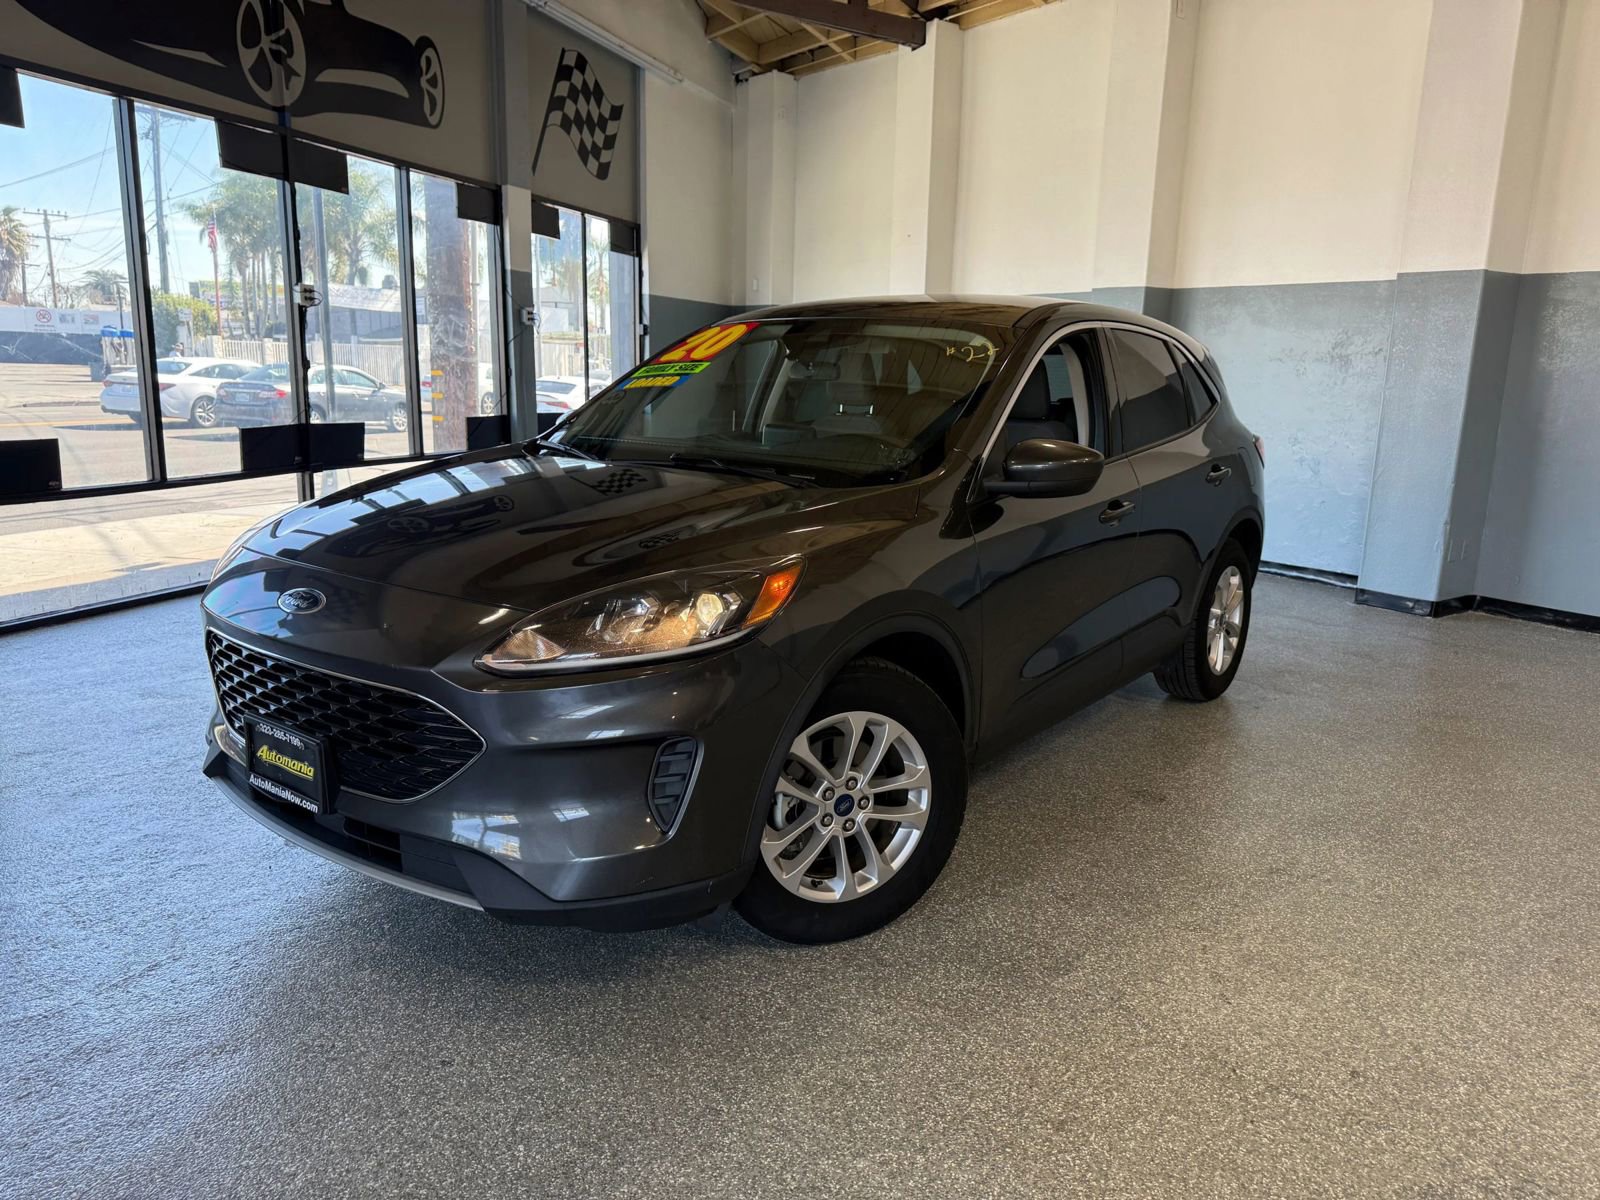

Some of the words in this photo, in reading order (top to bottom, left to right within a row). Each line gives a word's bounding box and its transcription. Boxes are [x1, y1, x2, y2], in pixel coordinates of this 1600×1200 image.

[659, 324, 748, 361] 20
[256, 744, 314, 777] Automania
[249, 774, 318, 813] AutoManiaNow.com
